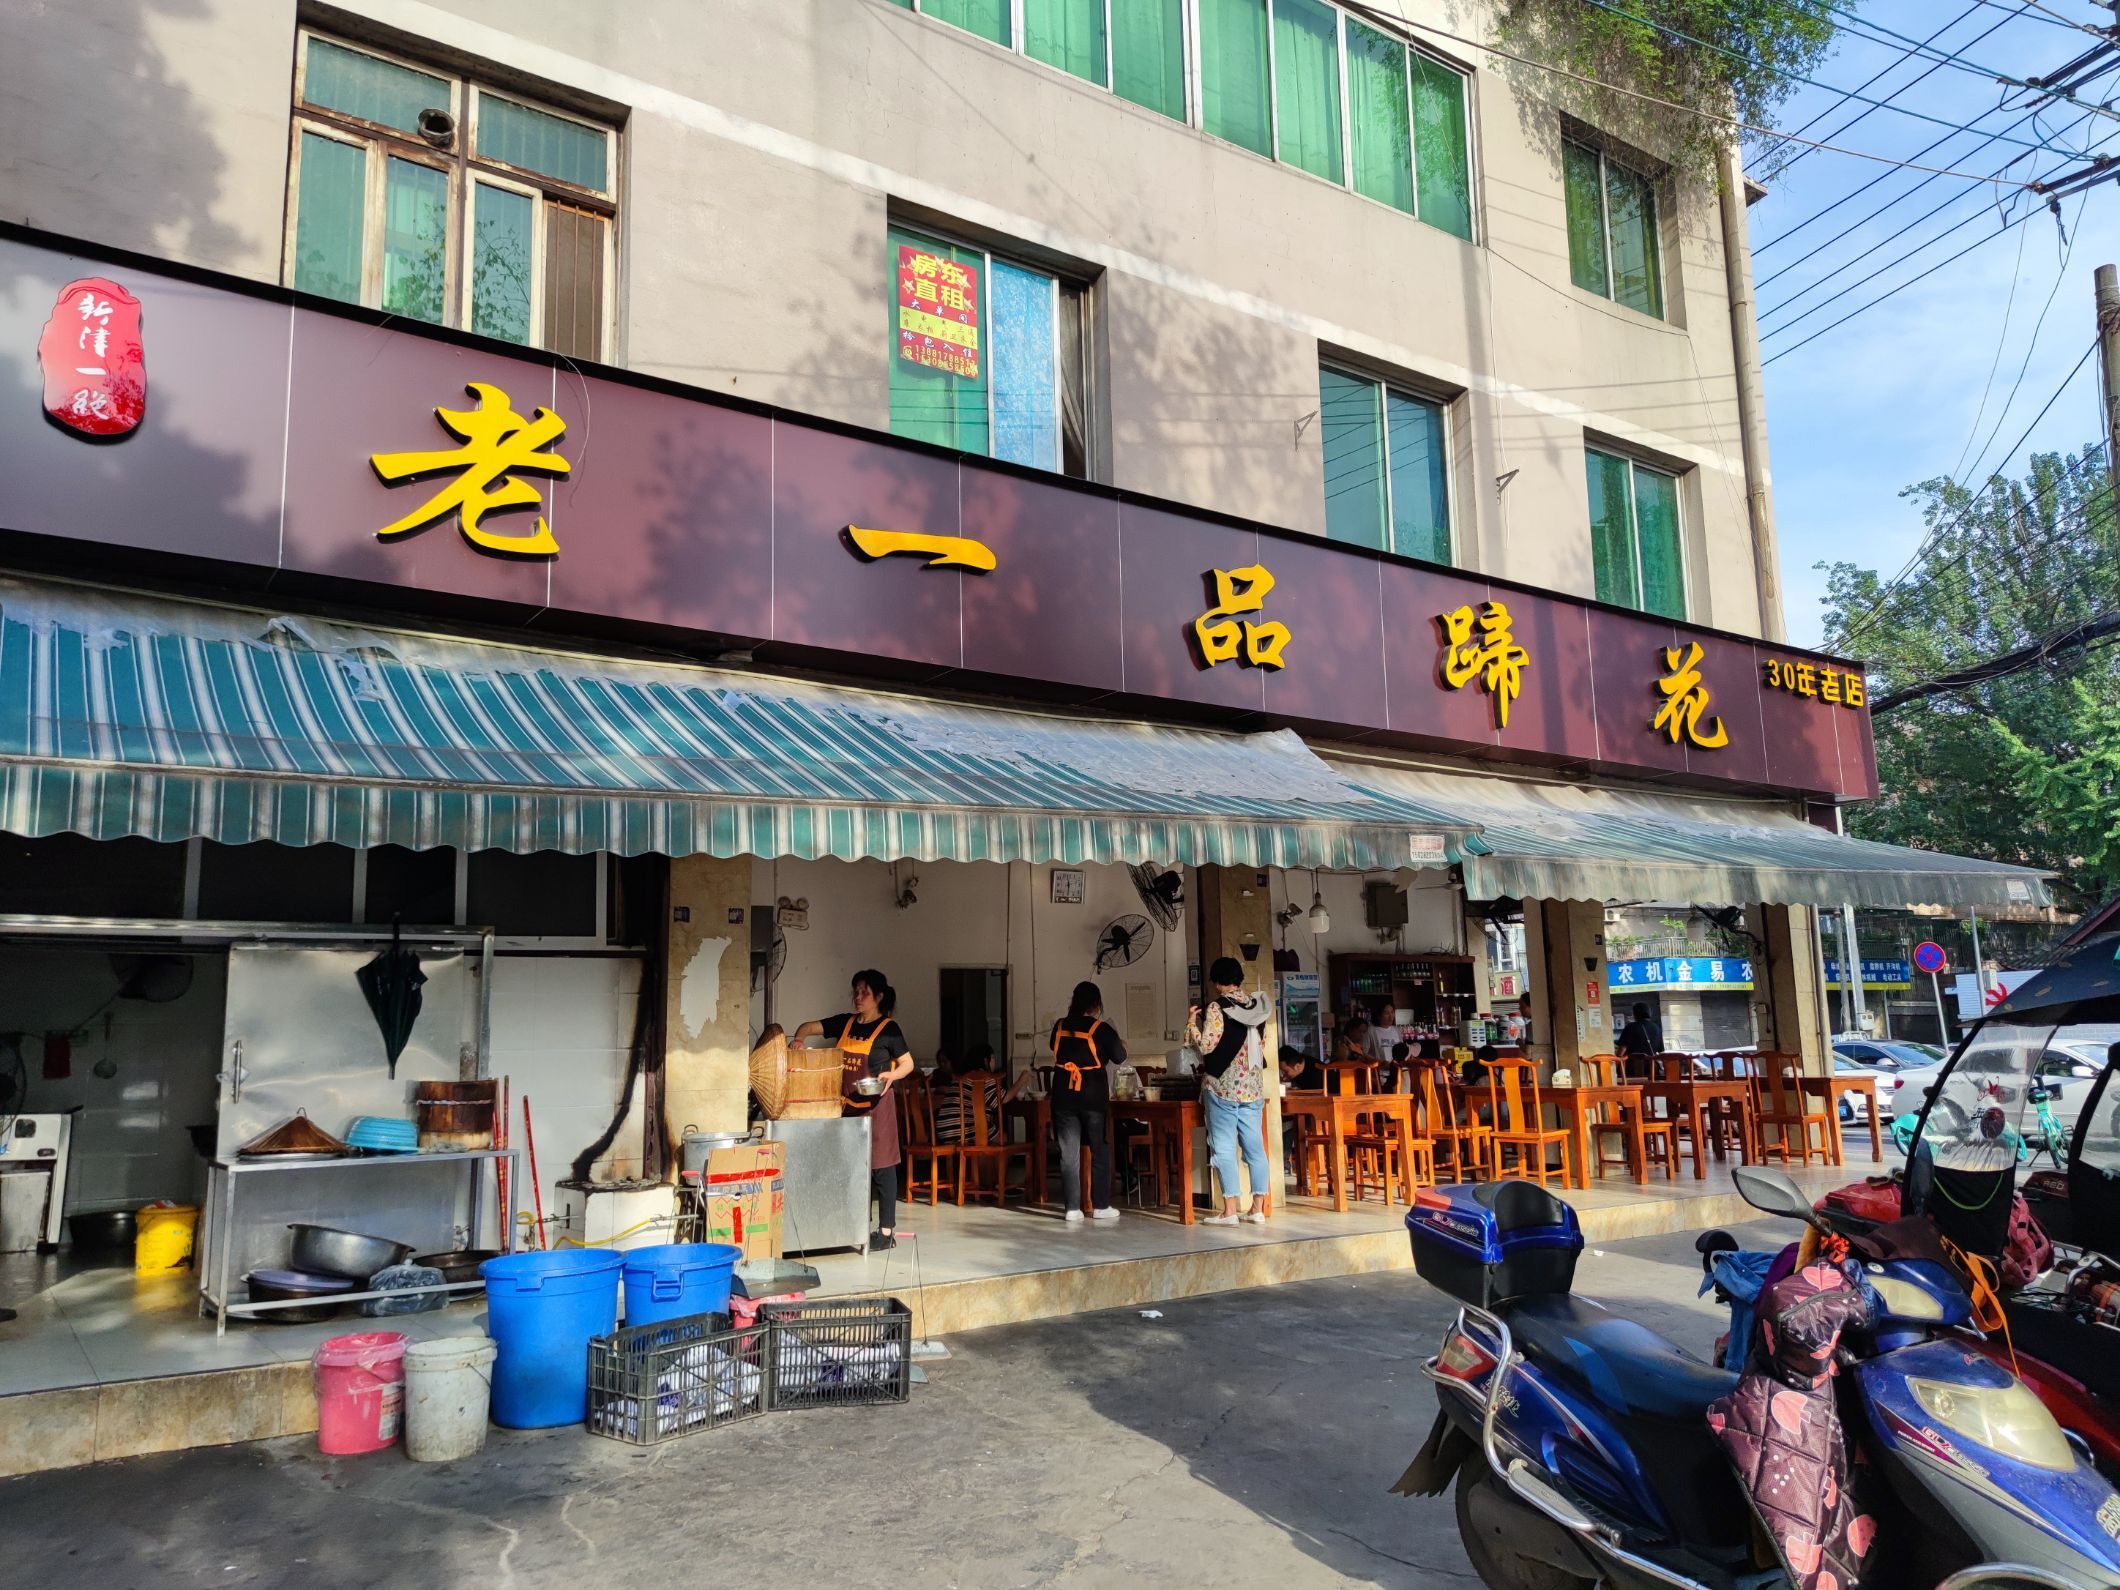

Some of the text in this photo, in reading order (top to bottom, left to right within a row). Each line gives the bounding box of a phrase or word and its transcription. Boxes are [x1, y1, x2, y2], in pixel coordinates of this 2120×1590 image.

[914, 253, 964, 286] 房东
[914, 276, 965, 310] 直租
[1768, 659, 1864, 706] 30年老店
